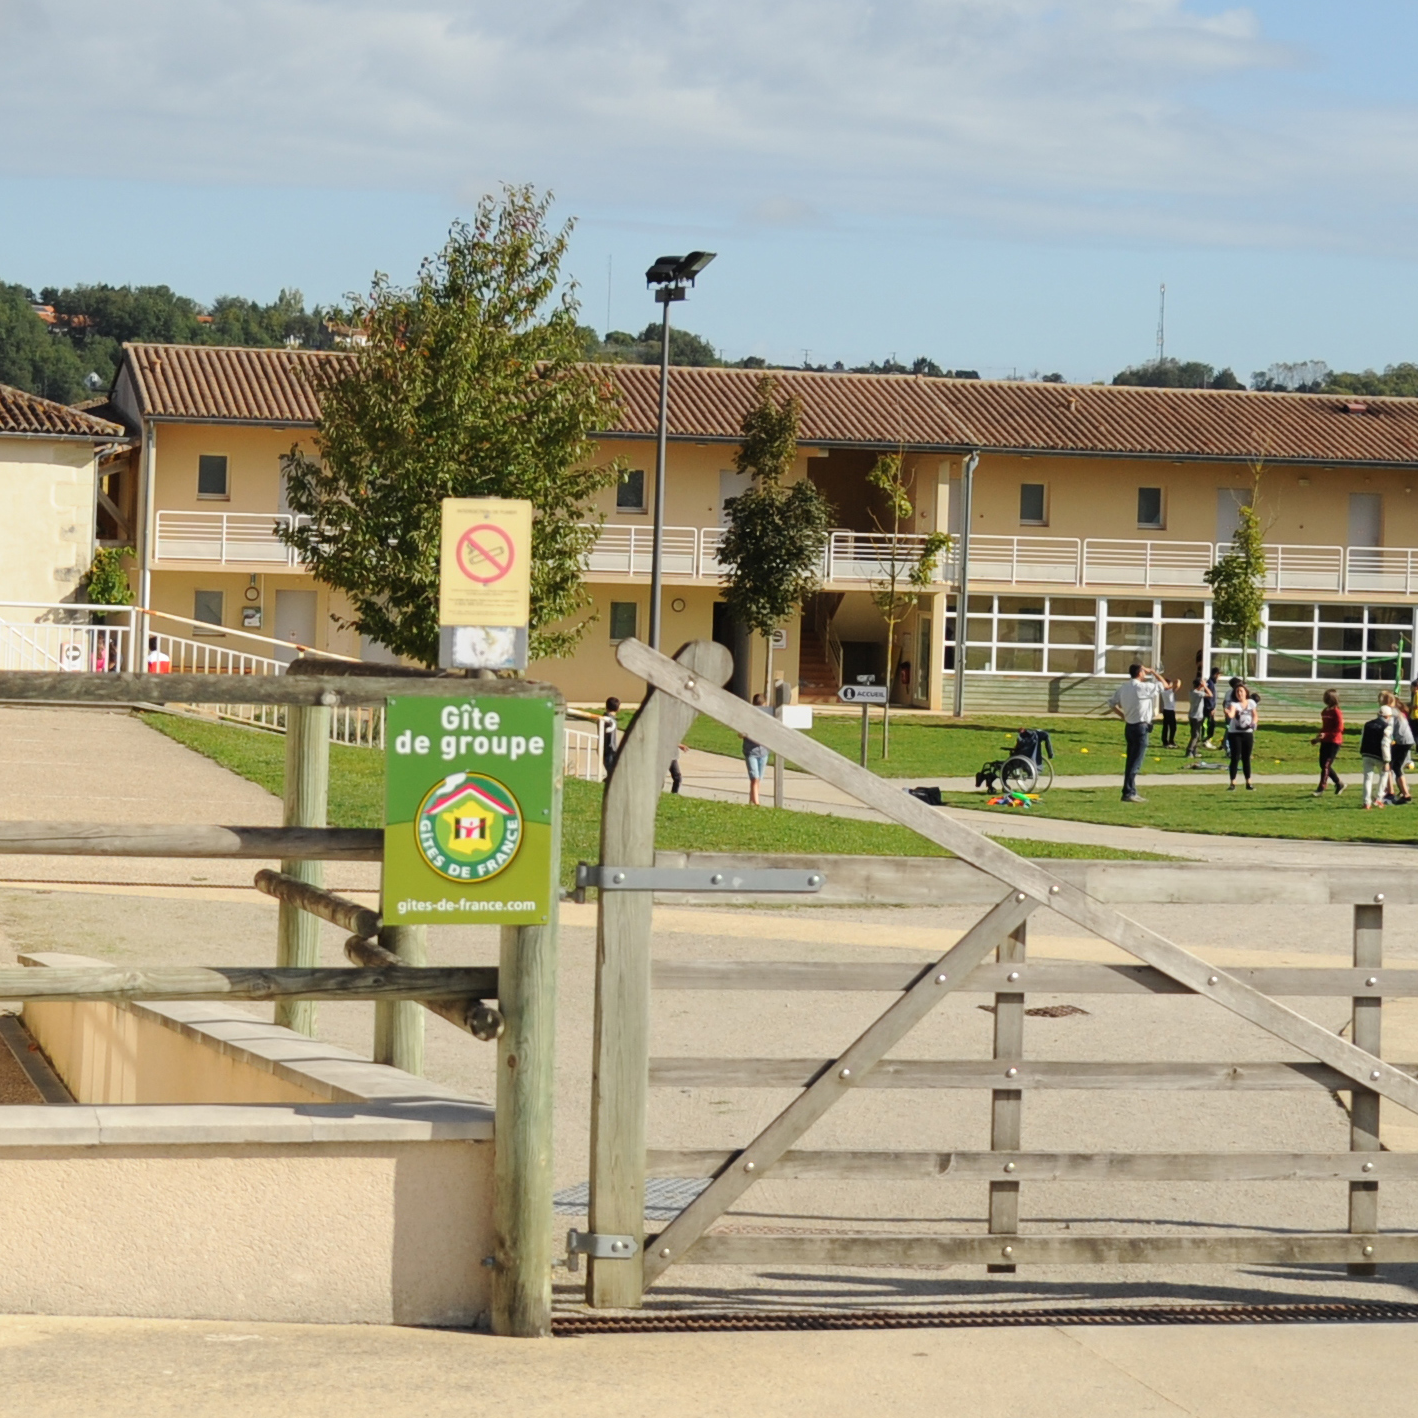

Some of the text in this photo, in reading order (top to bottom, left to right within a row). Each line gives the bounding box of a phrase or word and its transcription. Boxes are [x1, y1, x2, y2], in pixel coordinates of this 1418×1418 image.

[856, 690, 885, 698] ACCUEIL
[441, 703, 501, 731] Gîte
[395, 729, 545, 761] de groupe
[447, 863, 471, 879] DE
[477, 819, 519, 877] FRANCE
[397, 898, 537, 914] gites-de-france.com
